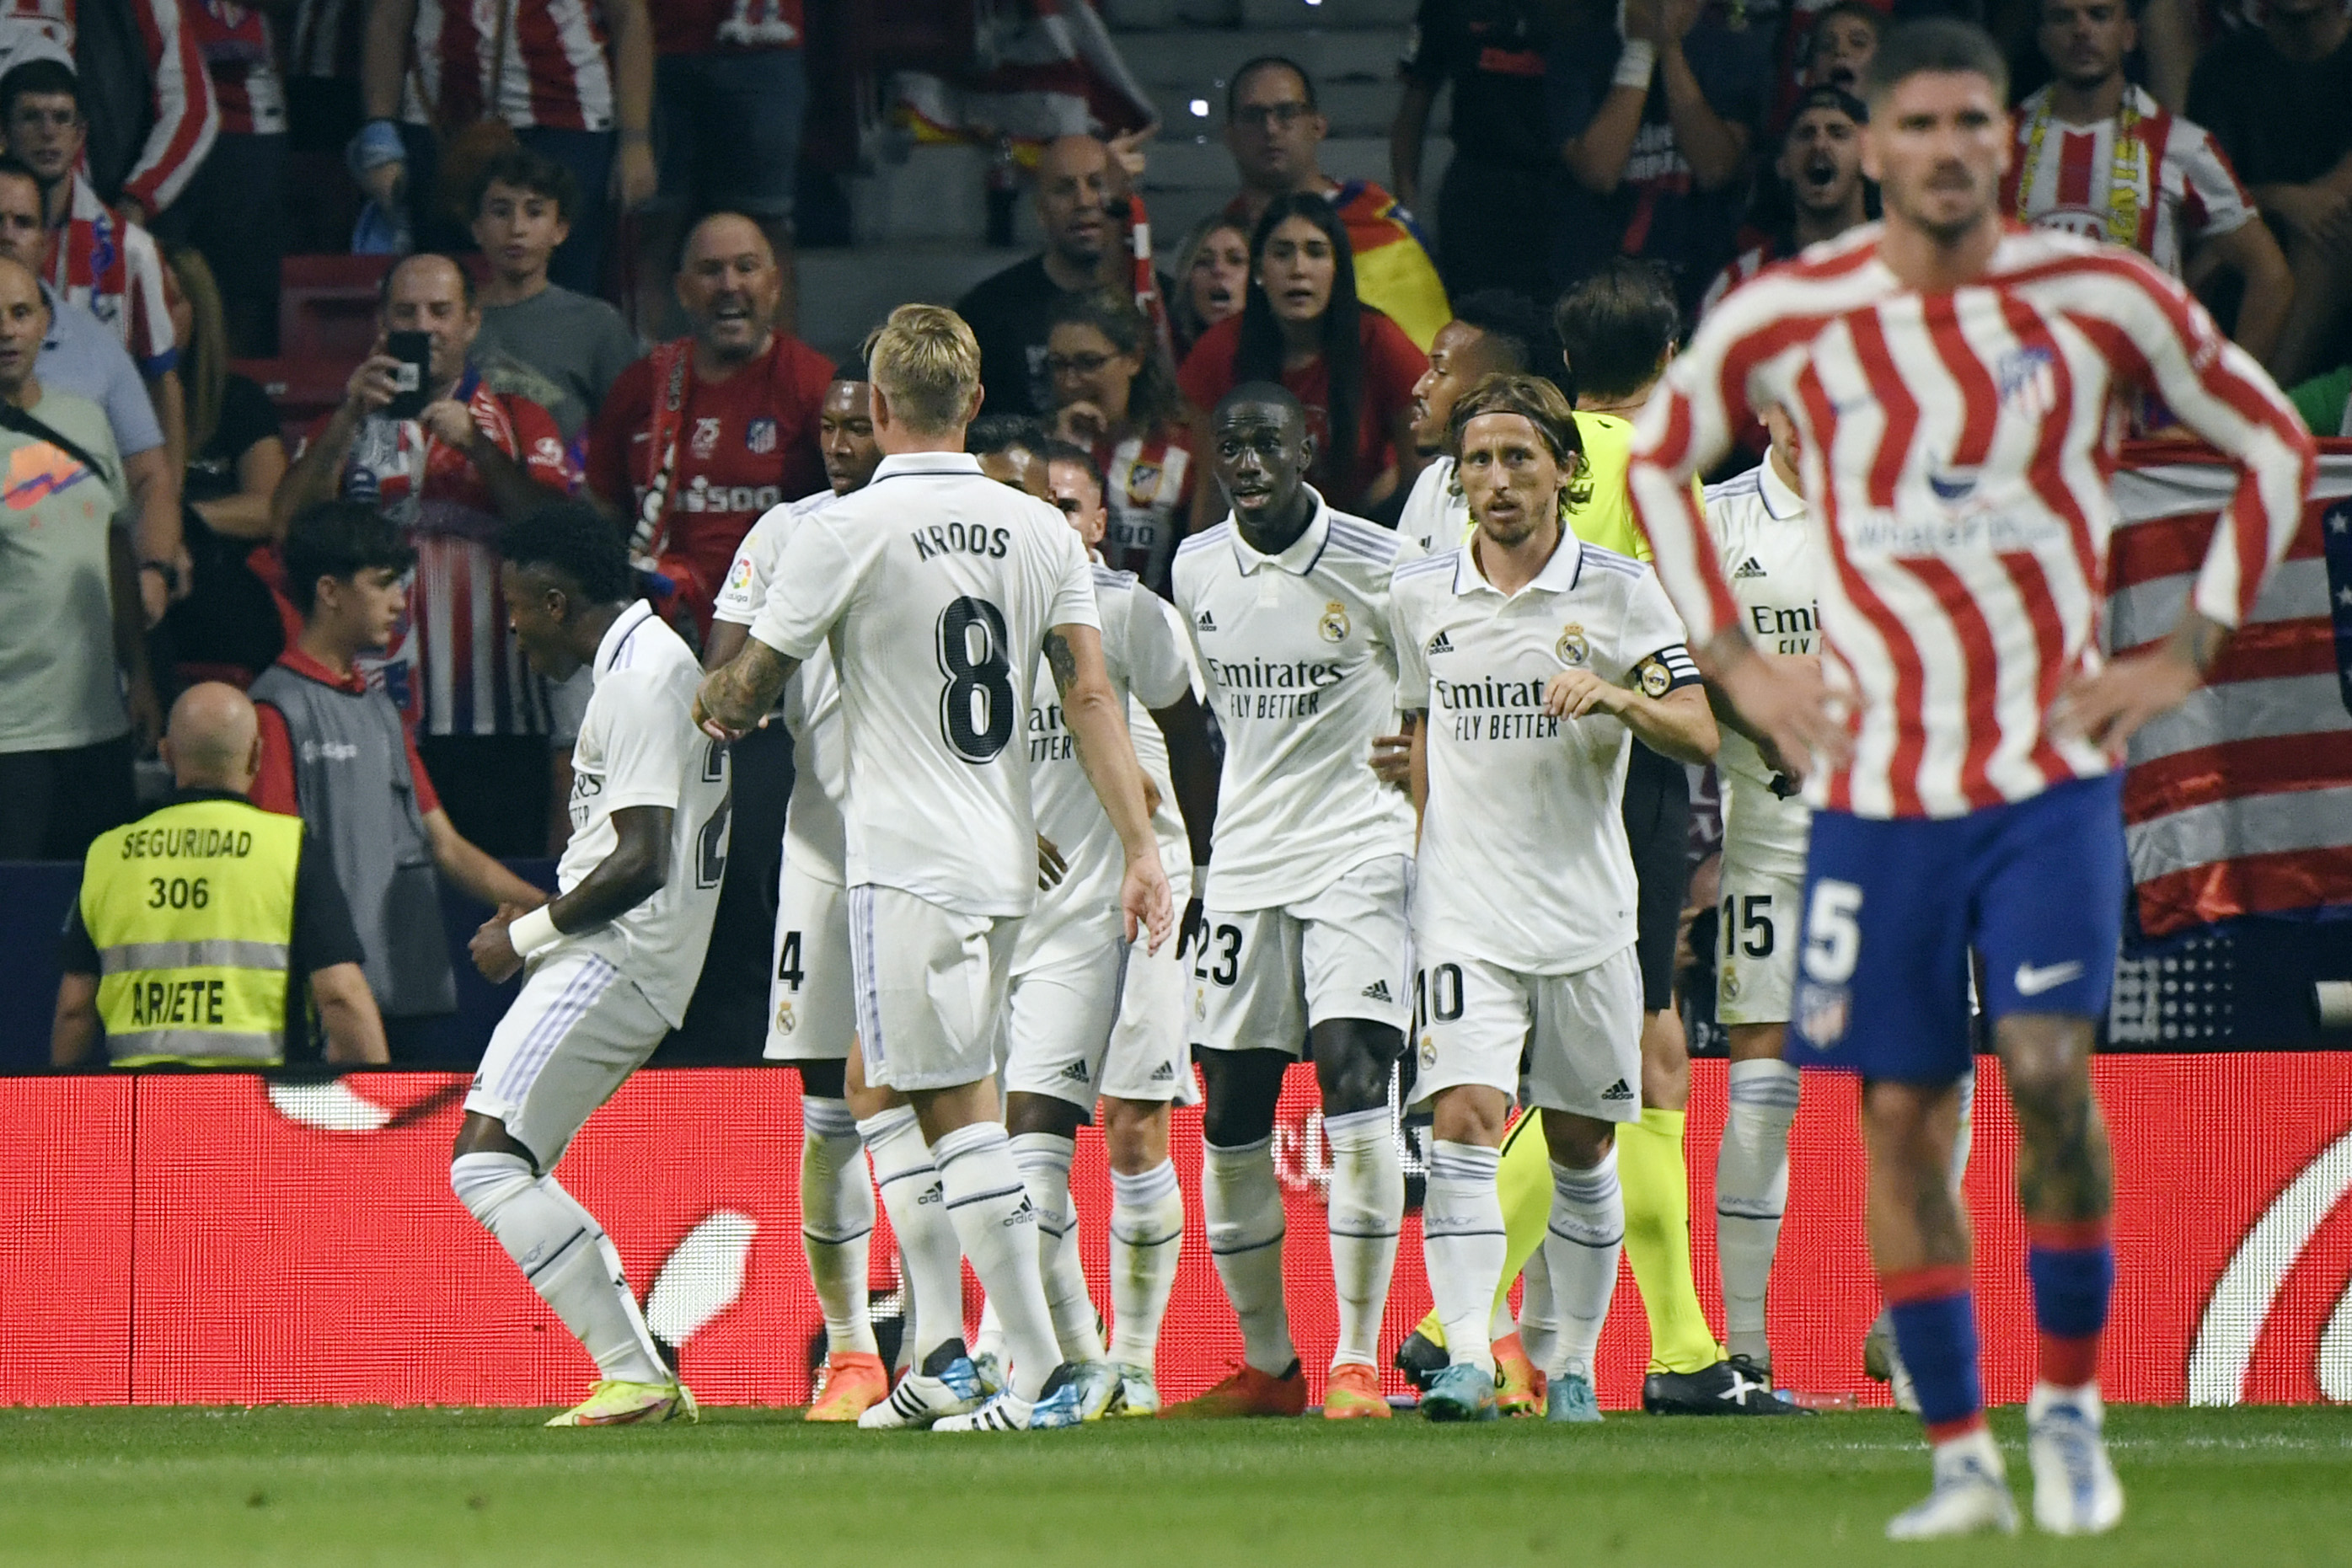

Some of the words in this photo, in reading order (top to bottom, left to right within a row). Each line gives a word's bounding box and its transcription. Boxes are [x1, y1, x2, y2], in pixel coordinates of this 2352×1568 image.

[909, 522, 1011, 564] KROOS
[1207, 656, 1345, 688] Emirates
[1428, 644, 1455, 656] adidas
[935, 595, 1014, 765] 8
[1230, 693, 1251, 718] FLY
[1256, 691, 1321, 720] BETTER
[1455, 715, 1482, 741] FLY
[1489, 713, 1558, 740] BETTER
[121, 828, 253, 860] SEGURIDAD
[147, 877, 210, 909] 306
[1723, 894, 1775, 960] 15
[1804, 878, 1864, 986] 5
[777, 930, 805, 994] 4
[1194, 917, 1243, 987] 23
[131, 980, 225, 1026] ARIETE
[1416, 962, 1464, 1027] 10
